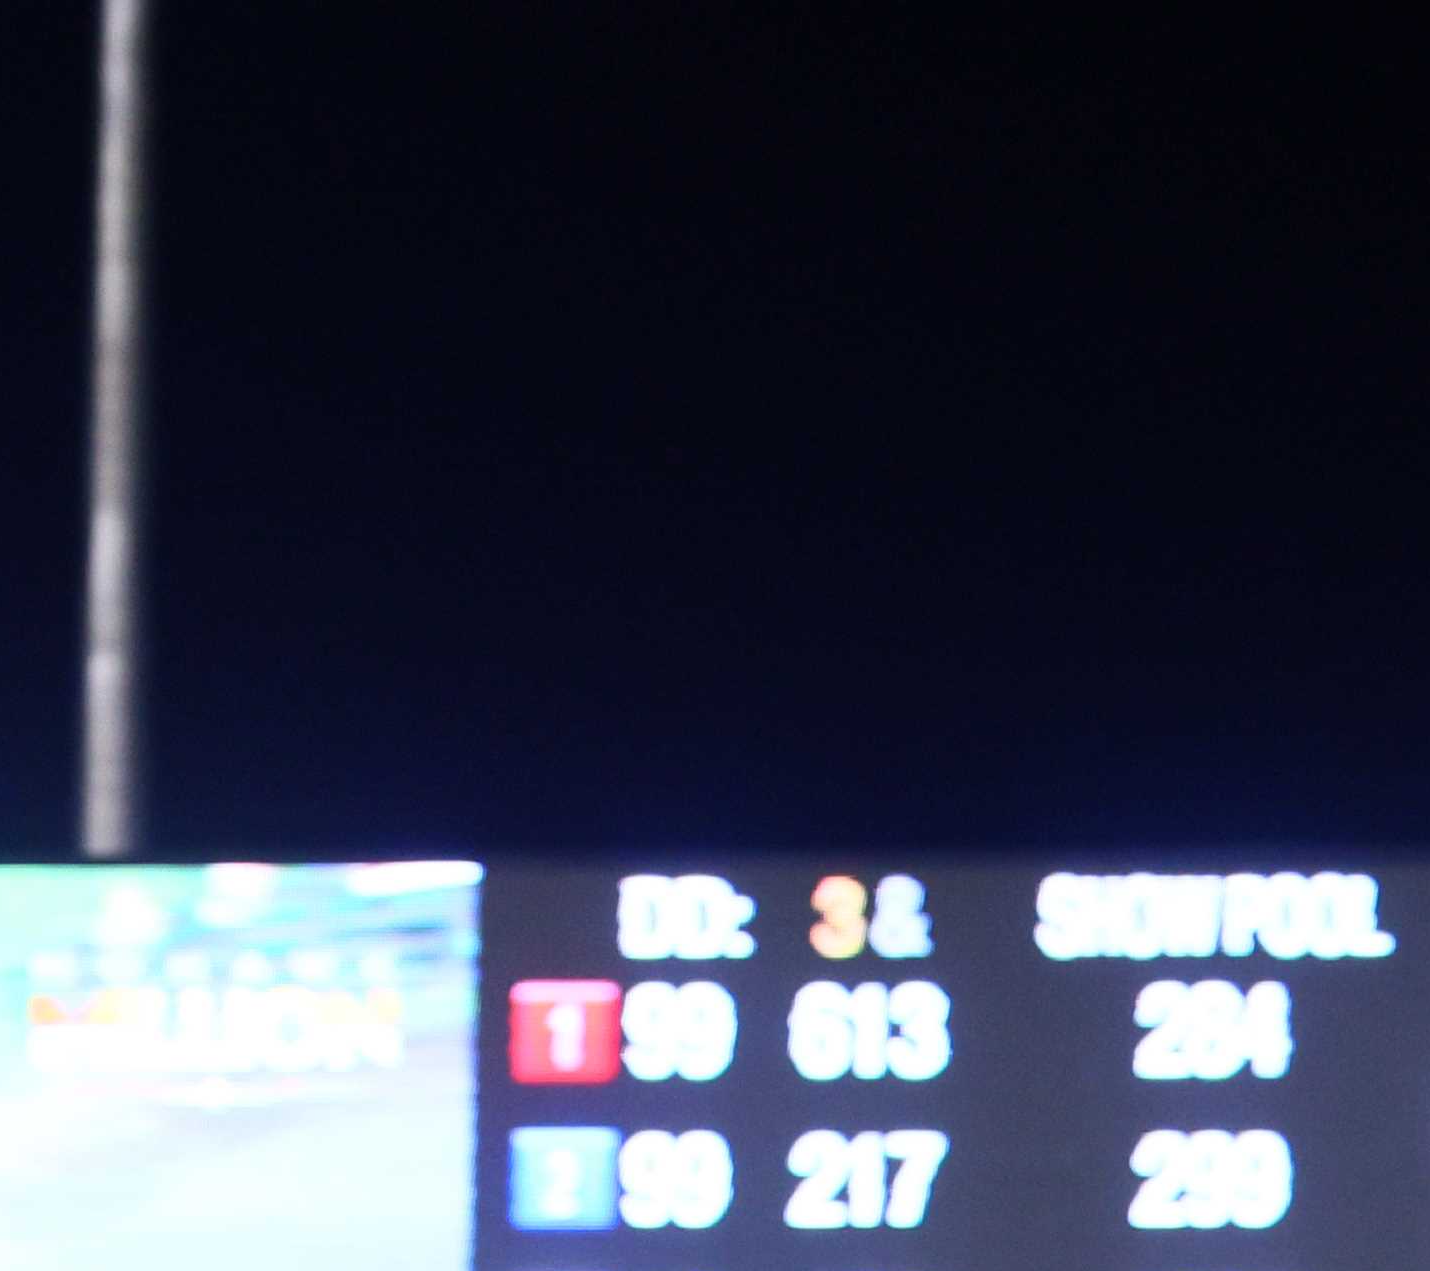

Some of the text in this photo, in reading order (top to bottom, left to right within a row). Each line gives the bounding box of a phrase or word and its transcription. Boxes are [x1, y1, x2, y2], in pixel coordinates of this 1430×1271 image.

[1033, 871, 1397, 960] SHOW POOL
[621, 980, 738, 1081] 99
[786, 979, 953, 1081] 613
[618, 1129, 735, 1230] 99
[783, 1127, 950, 1229] 217
[1127, 1127, 1296, 1230] 299
